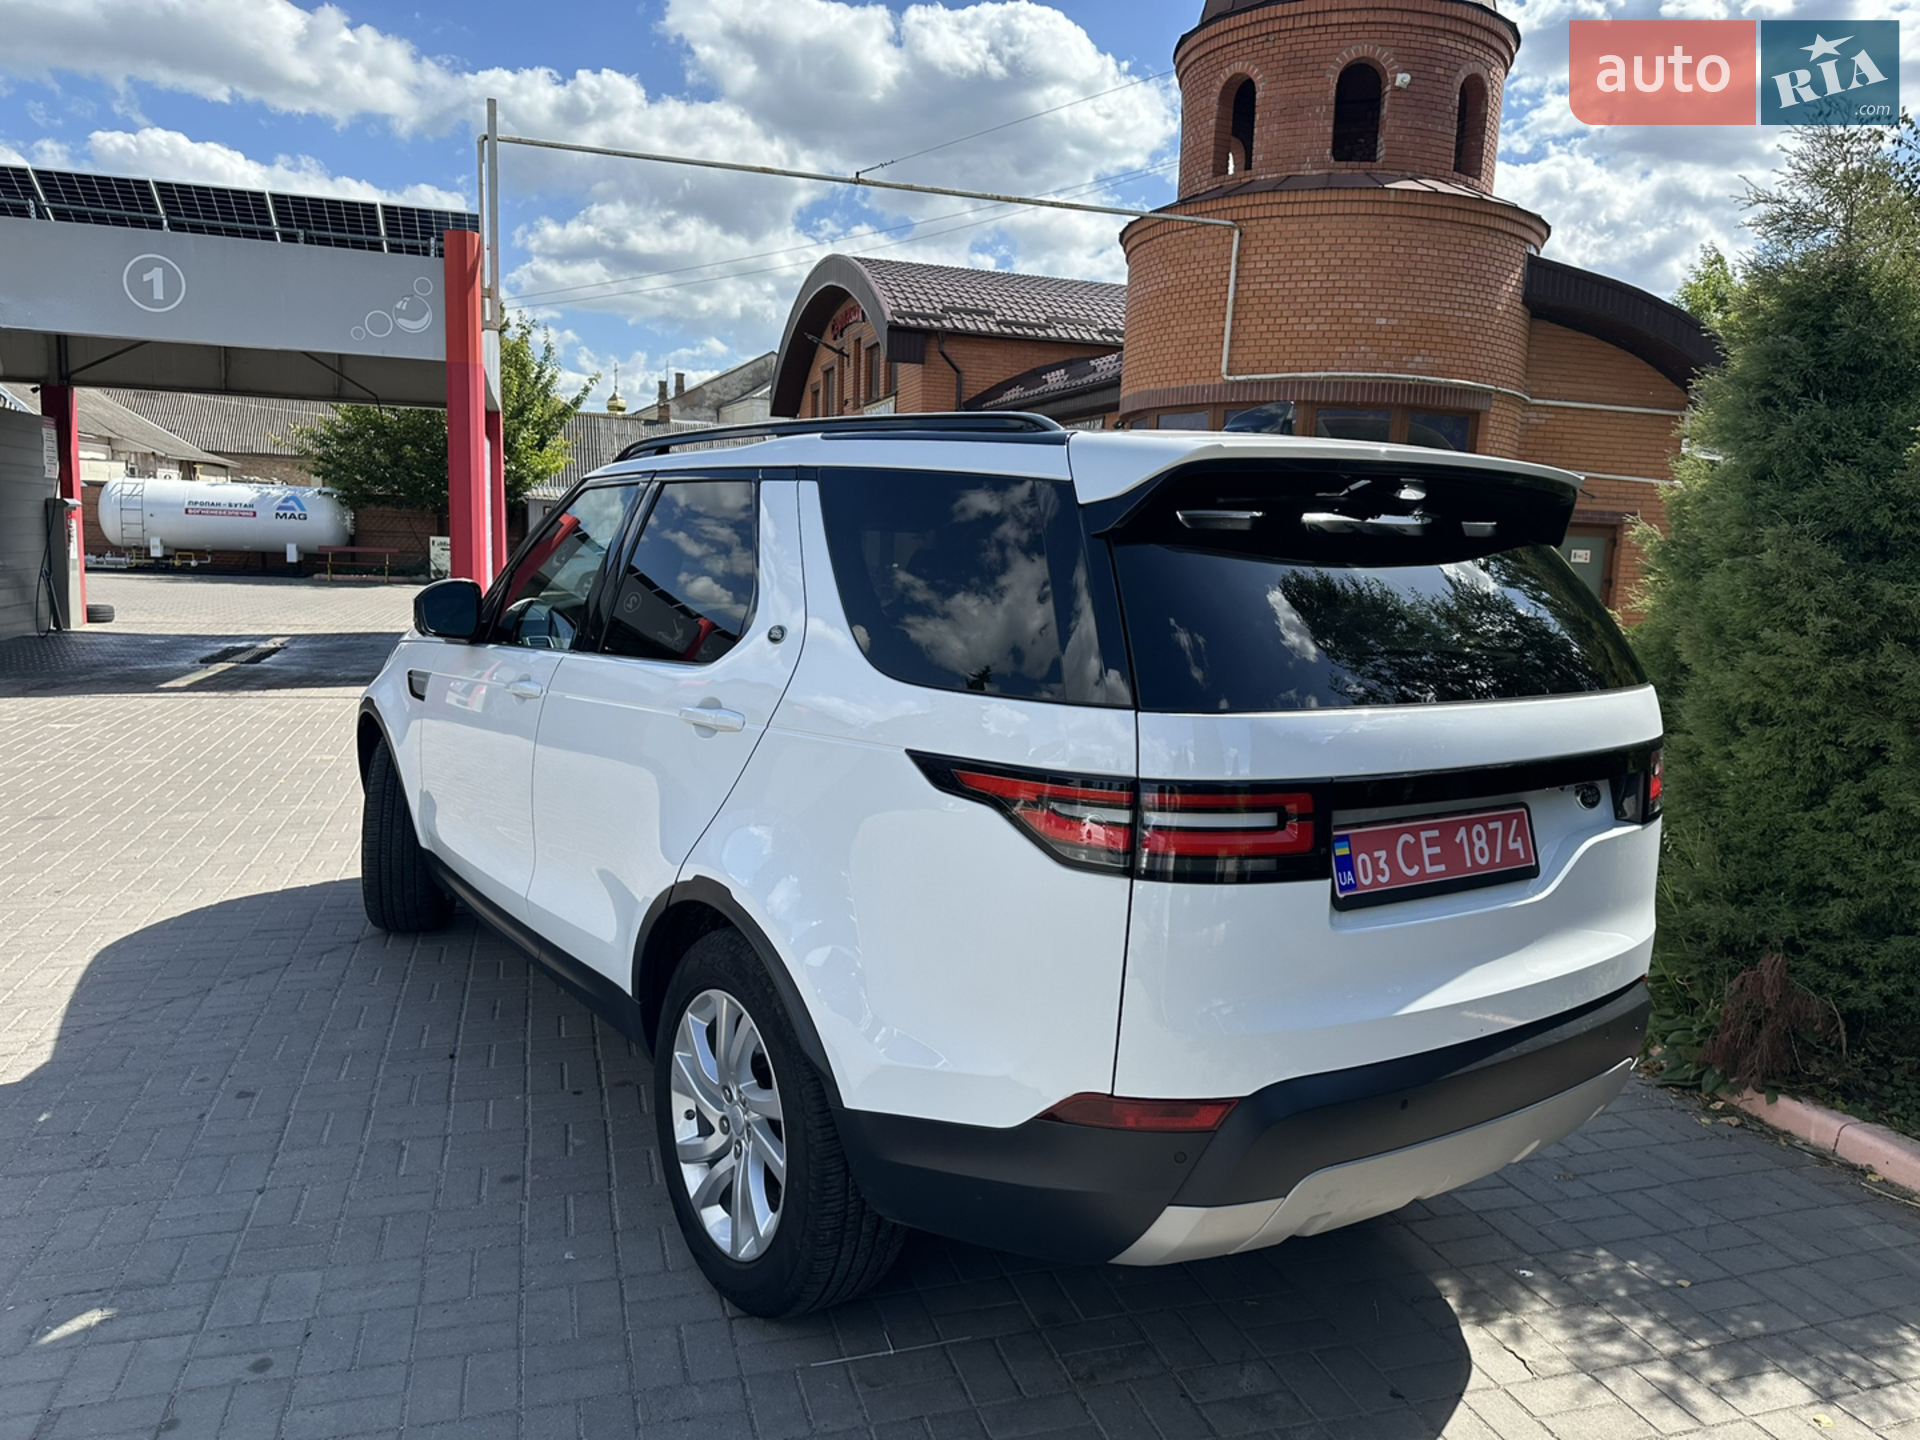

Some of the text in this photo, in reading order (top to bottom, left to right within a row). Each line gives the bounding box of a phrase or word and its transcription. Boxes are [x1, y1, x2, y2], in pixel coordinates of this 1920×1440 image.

[142, 267, 164, 300] 1
[275, 512, 308, 520] MAG
[1356, 818, 1525, 886] 03 CE 1874
[1338, 871, 1355, 886] UA
